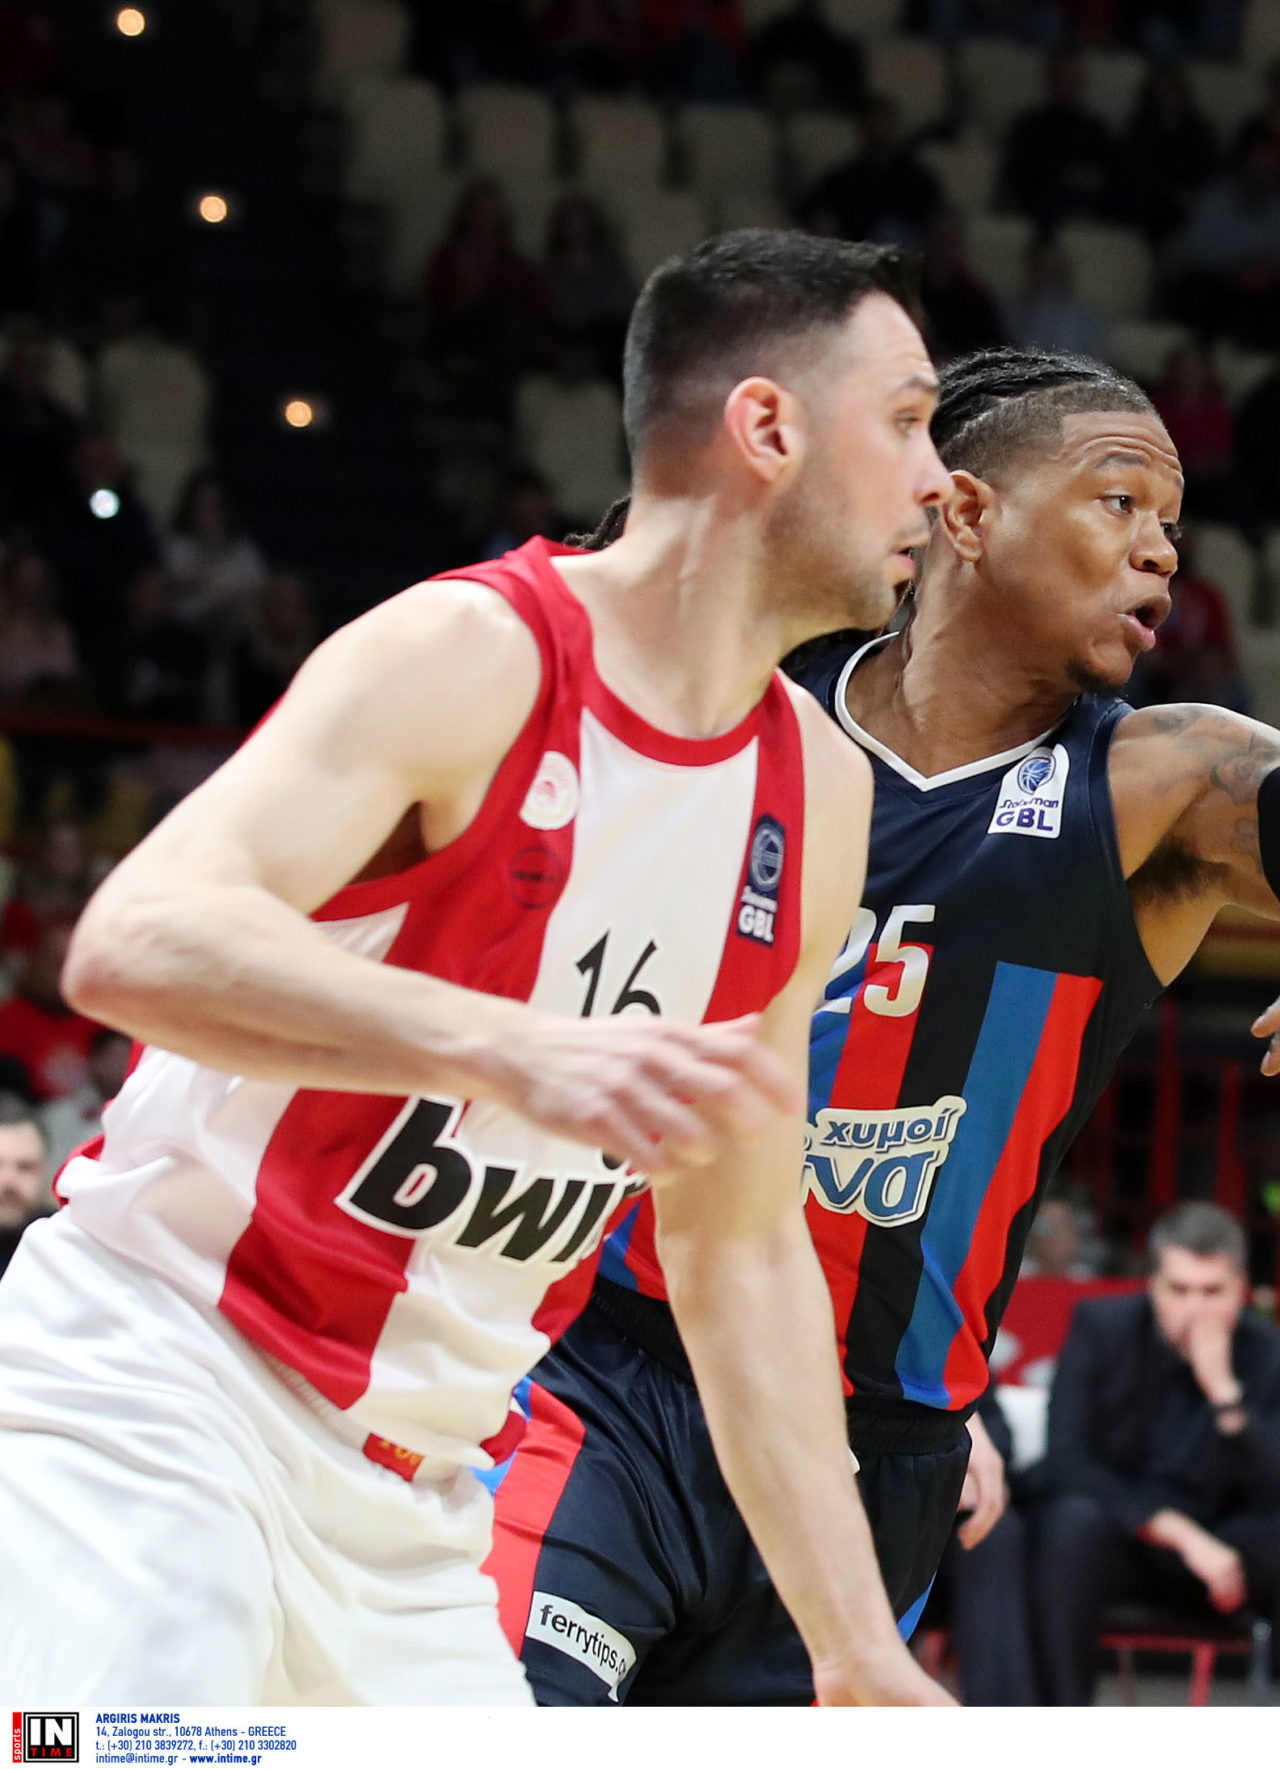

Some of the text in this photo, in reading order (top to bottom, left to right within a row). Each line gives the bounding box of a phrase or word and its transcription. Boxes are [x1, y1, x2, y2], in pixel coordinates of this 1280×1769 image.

[996, 808, 1053, 831] GBL
[738, 904, 774, 942] GBL
[349, 1097, 646, 1263] bwi
[803, 1150, 936, 1219] va
